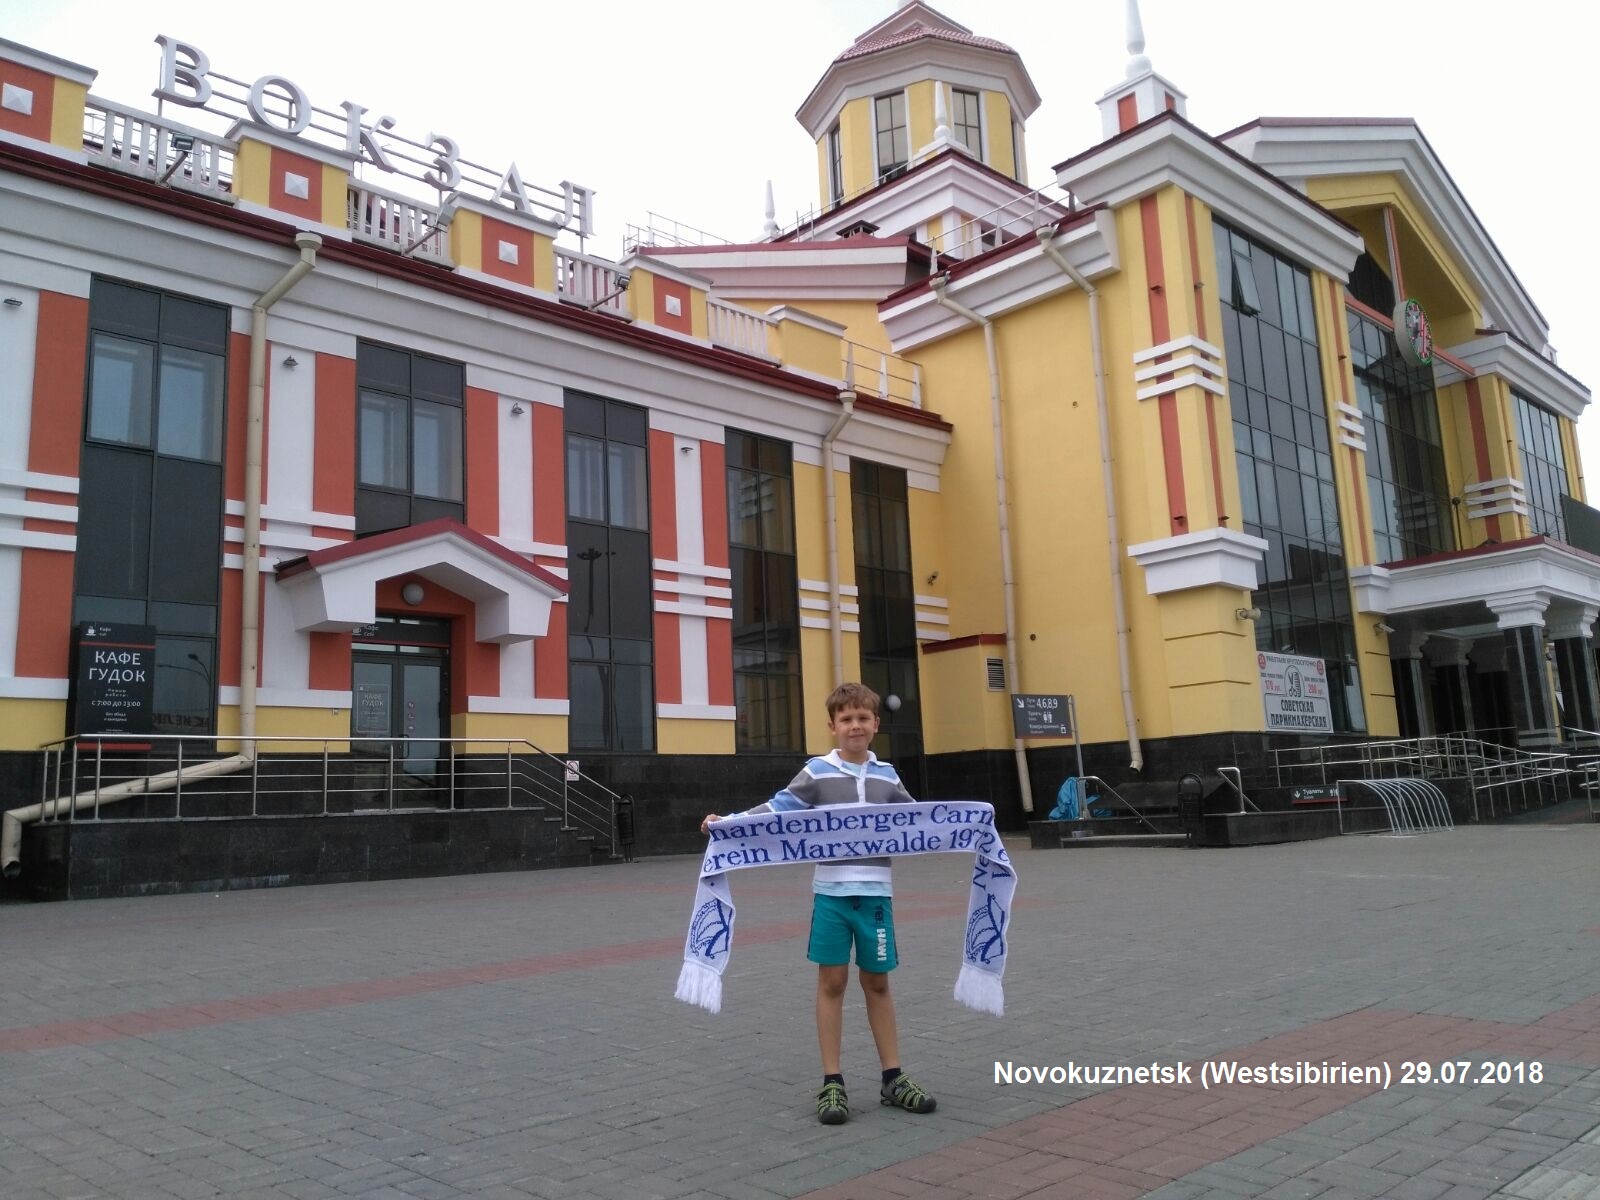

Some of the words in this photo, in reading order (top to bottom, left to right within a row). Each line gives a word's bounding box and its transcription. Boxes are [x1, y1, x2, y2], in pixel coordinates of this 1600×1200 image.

[151, 34, 597, 236] ВОКЗАЛ
[95, 651, 141, 665] КАФЕ
[89, 668, 145, 684] ГУДОК
[1280, 699, 1315, 713] СОВЕТСКАЯ
[1270, 713, 1328, 728] ПАРИКМАХЕРСКАЯ
[782, 829, 940, 860] Marxwalde
[949, 828, 996, 853] 1972
